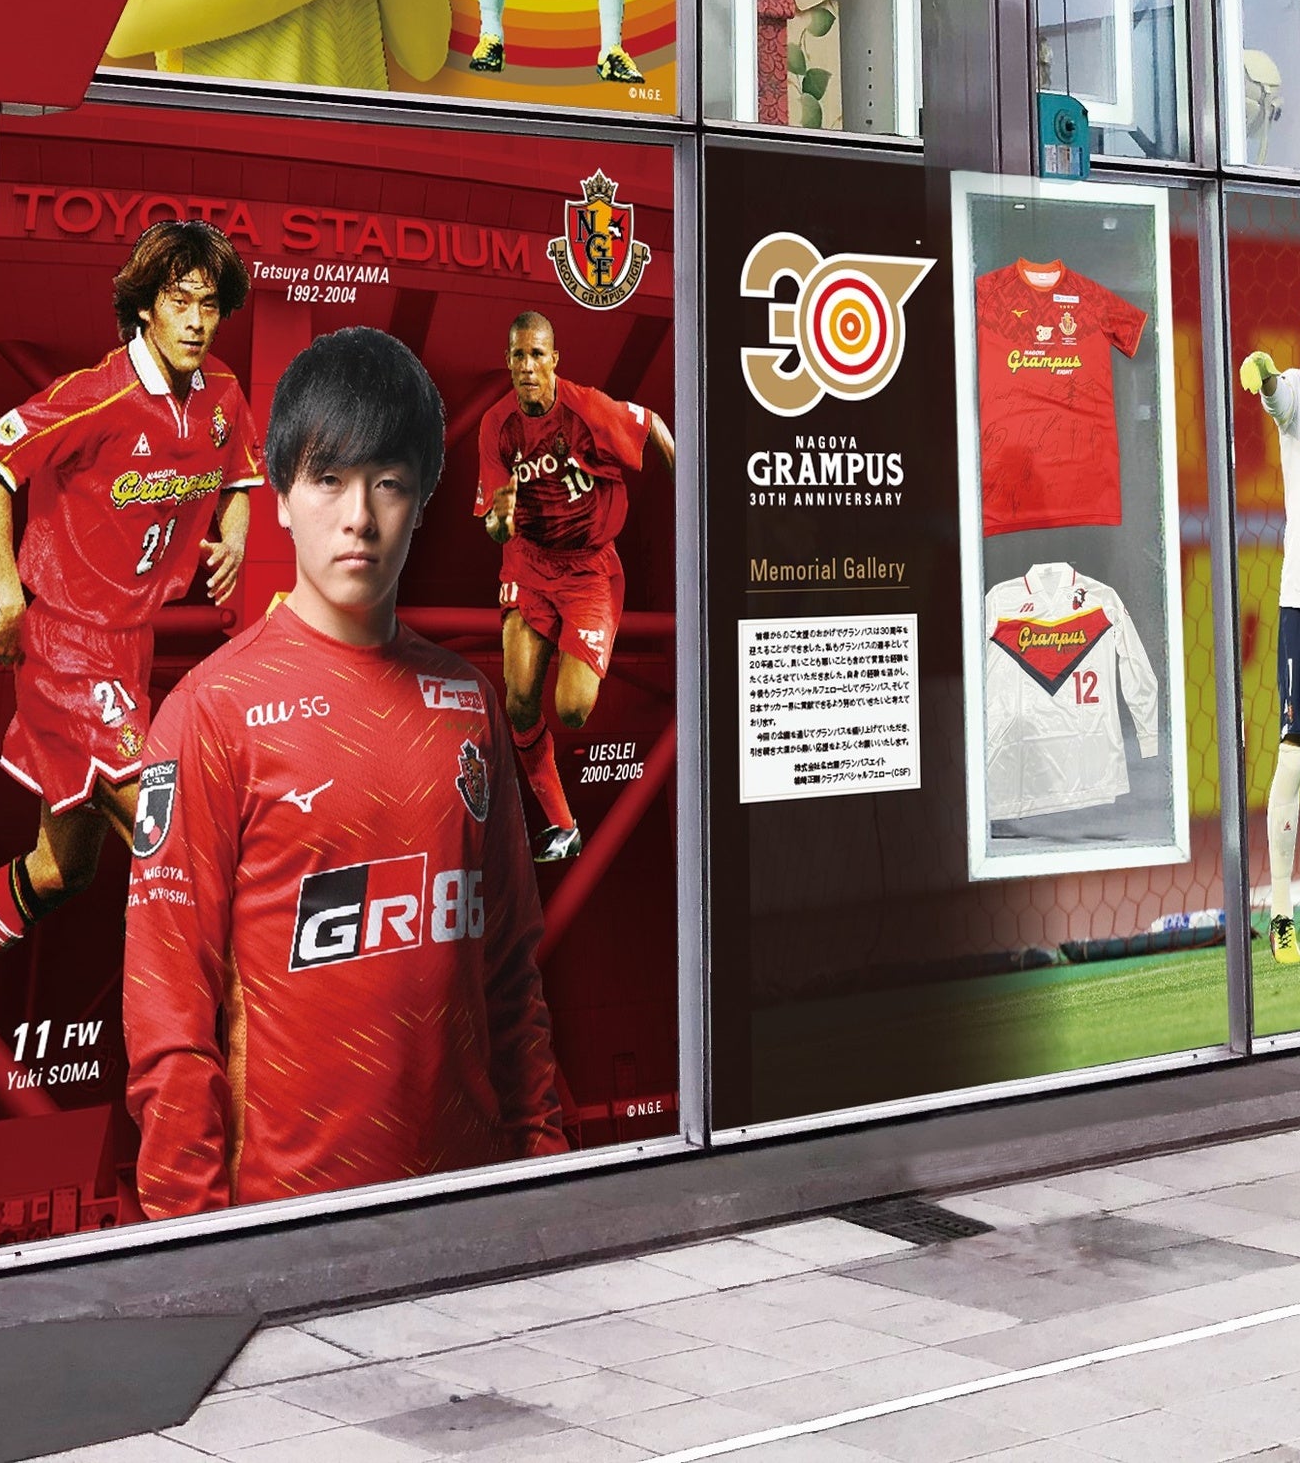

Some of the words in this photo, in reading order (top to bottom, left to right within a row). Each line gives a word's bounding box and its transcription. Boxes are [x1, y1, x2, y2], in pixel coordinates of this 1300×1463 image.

[282, 207, 532, 274] STADIUM
[253, 260, 309, 285] Tetsuya
[313, 264, 390, 285] OKAYAMA
[556, 249, 578, 293] NAGOYA
[581, 287, 627, 305] GRAMPUS
[628, 252, 643, 287] EIGHT
[286, 284, 356, 304] 1992-2004
[1007, 349, 1082, 374] Grampus
[795, 435, 857, 450] NAGOYA
[746, 451, 905, 488] GRAMPUS
[750, 492, 788, 507] 30TH
[794, 492, 904, 507] ANNIVERSARY
[750, 558, 836, 583] Memorial
[843, 558, 907, 585] Gallery
[1018, 626, 1087, 653] Grampus
[94, 679, 138, 724] 21
[1072, 670, 1100, 705] 12
[246, 701, 296, 727] au
[298, 696, 331, 719] 5G
[589, 742, 636, 762] UESLEI
[580, 762, 645, 784] 2000-2005
[431, 869, 485, 944] 86
[298, 894, 419, 962] GR
[11, 1020, 52, 1063] 11
[62, 1020, 103, 1050] FW
[5, 1066, 45, 1091] Yuki
[47, 1060, 102, 1087] SOMA
